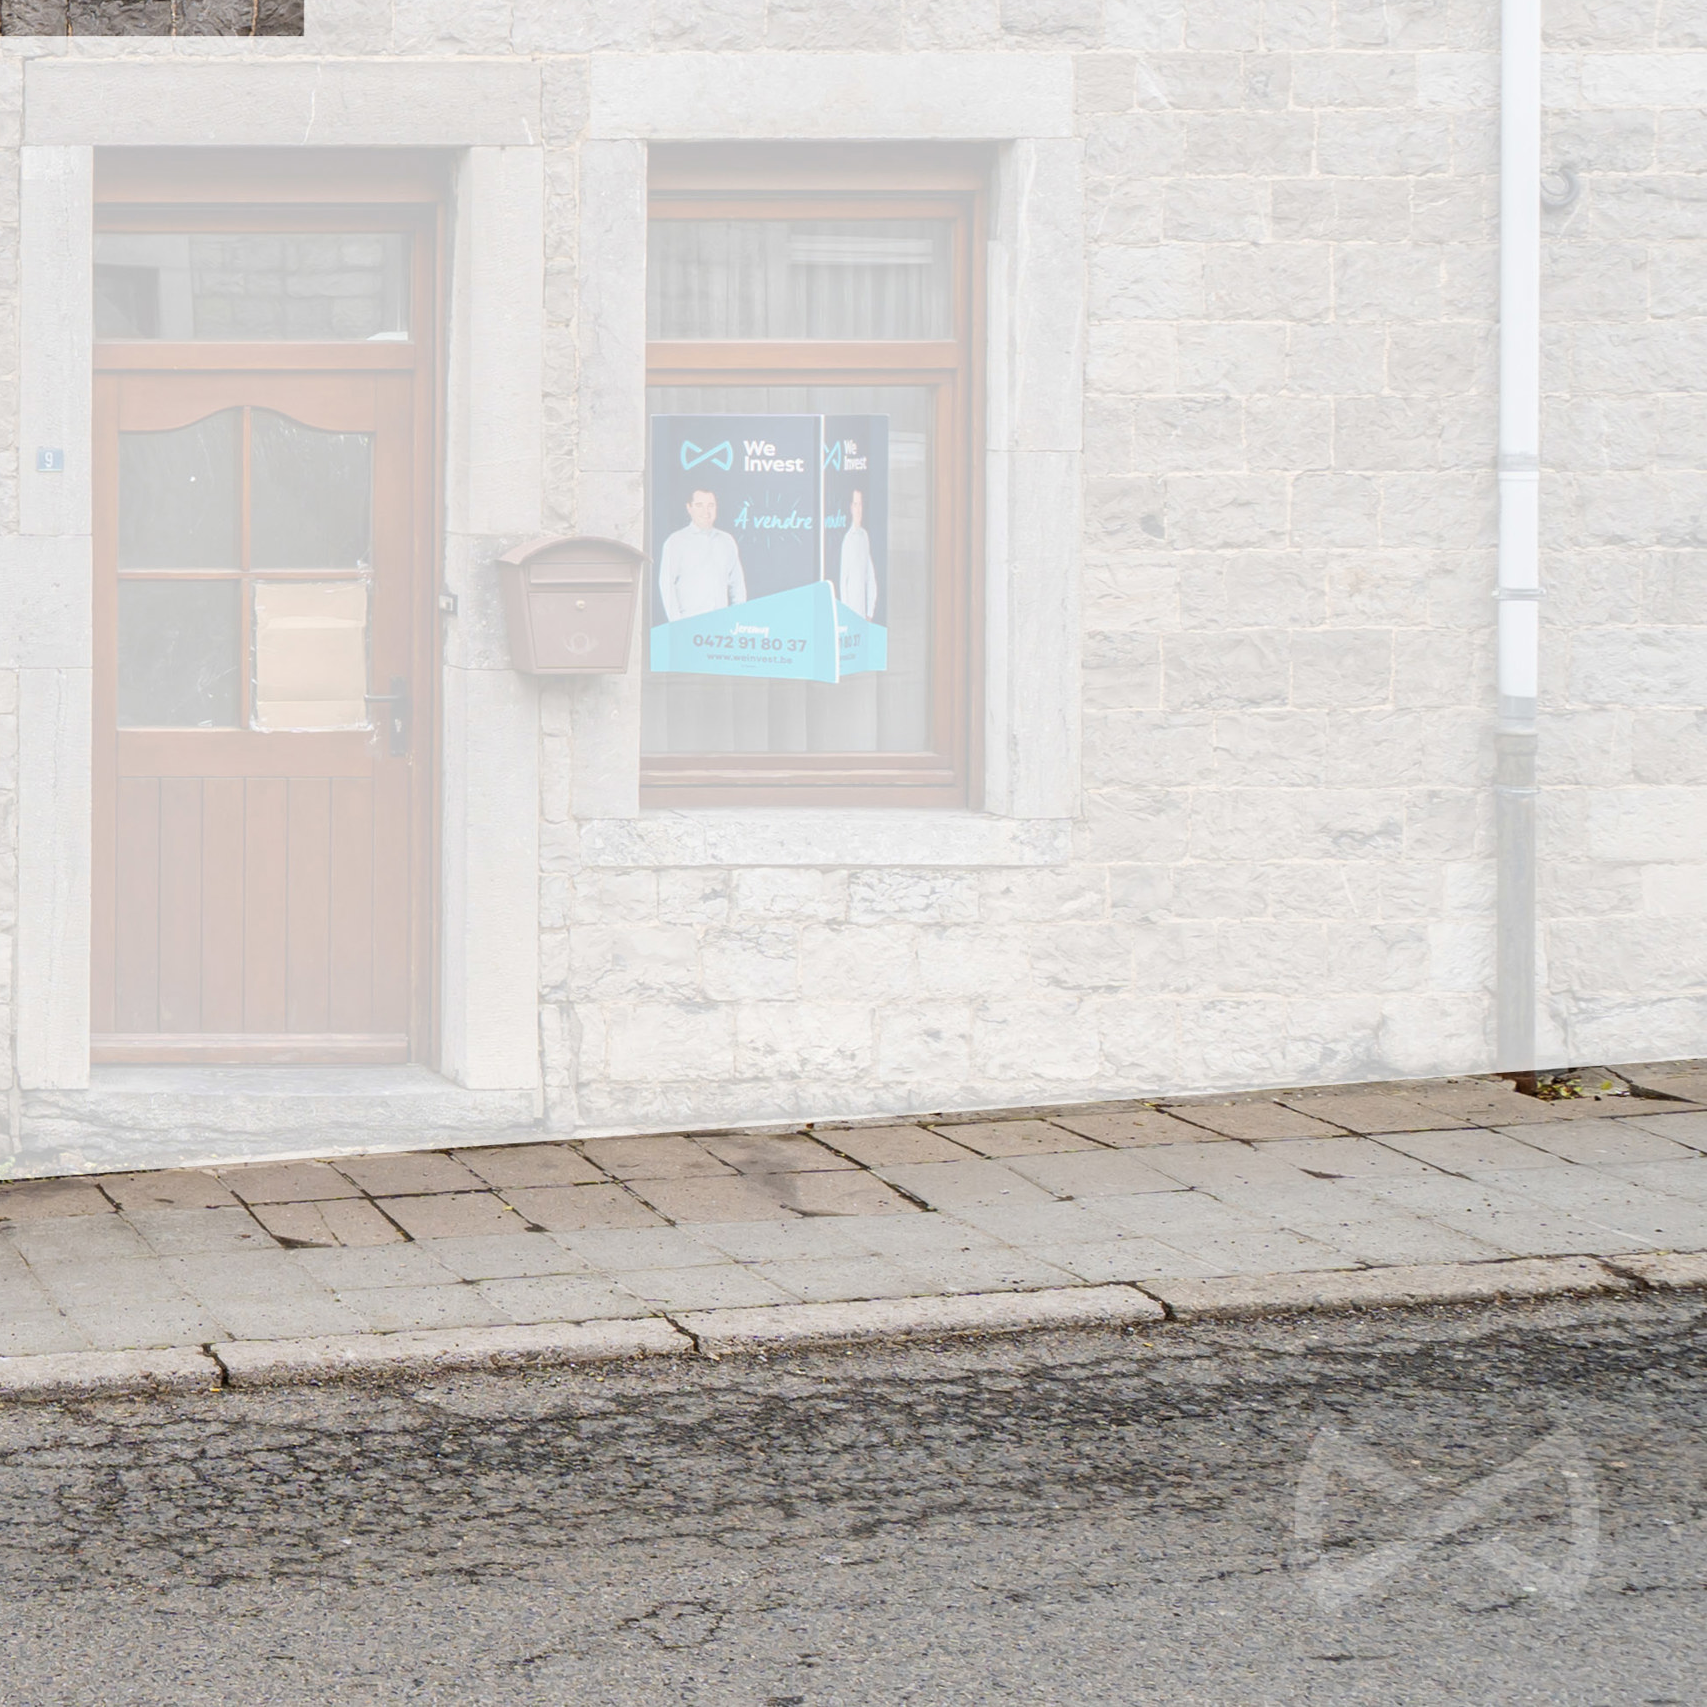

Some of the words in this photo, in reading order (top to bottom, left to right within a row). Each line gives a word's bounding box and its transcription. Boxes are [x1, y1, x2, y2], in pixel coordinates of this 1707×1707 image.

[743, 440, 776, 456] We
[843, 439, 858, 455] We
[44, 451, 53, 468] 9
[744, 455, 804, 472] Invest
[733, 500, 750, 530] À
[753, 509, 814, 530] vendre
[692, 634, 734, 649] 0472
[738, 636, 756, 650] 91
[760, 637, 783, 652] 80
[787, 638, 807, 653] 37
[706, 653, 793, 665] www.weinvest.be
